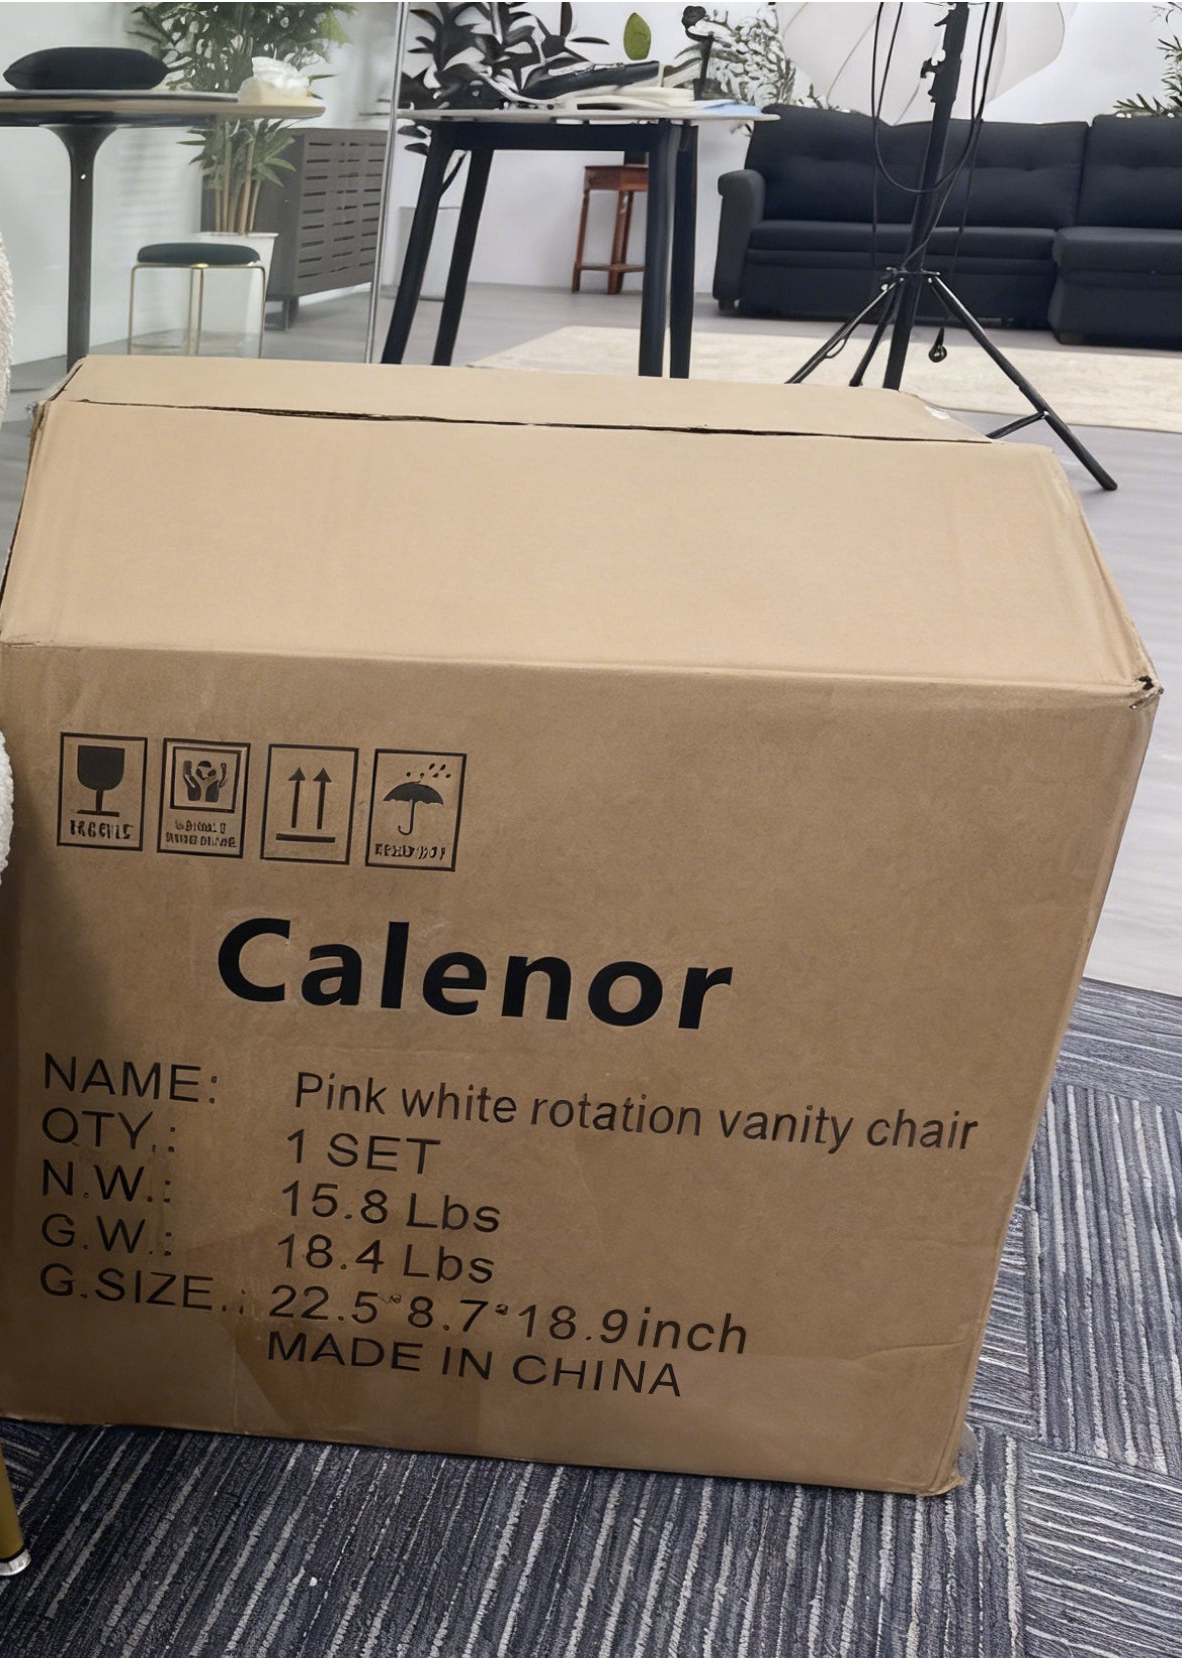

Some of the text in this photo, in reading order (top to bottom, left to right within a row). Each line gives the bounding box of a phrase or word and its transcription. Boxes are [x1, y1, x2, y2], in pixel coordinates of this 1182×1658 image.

[217, 917, 734, 1030] Calenor
[44, 1052, 979, 1155] NAME: Pink white rotation vanity chair
[286, 1128, 306, 1164] 1
[327, 1132, 442, 1175] SET
[281, 1179, 389, 1225] 15.8
[405, 1192, 502, 1234] Lbs
[277, 1233, 385, 1275] 18.4
[402, 1243, 496, 1285] Lbs
[267, 1330, 681, 1398] MADE IN CHINA
